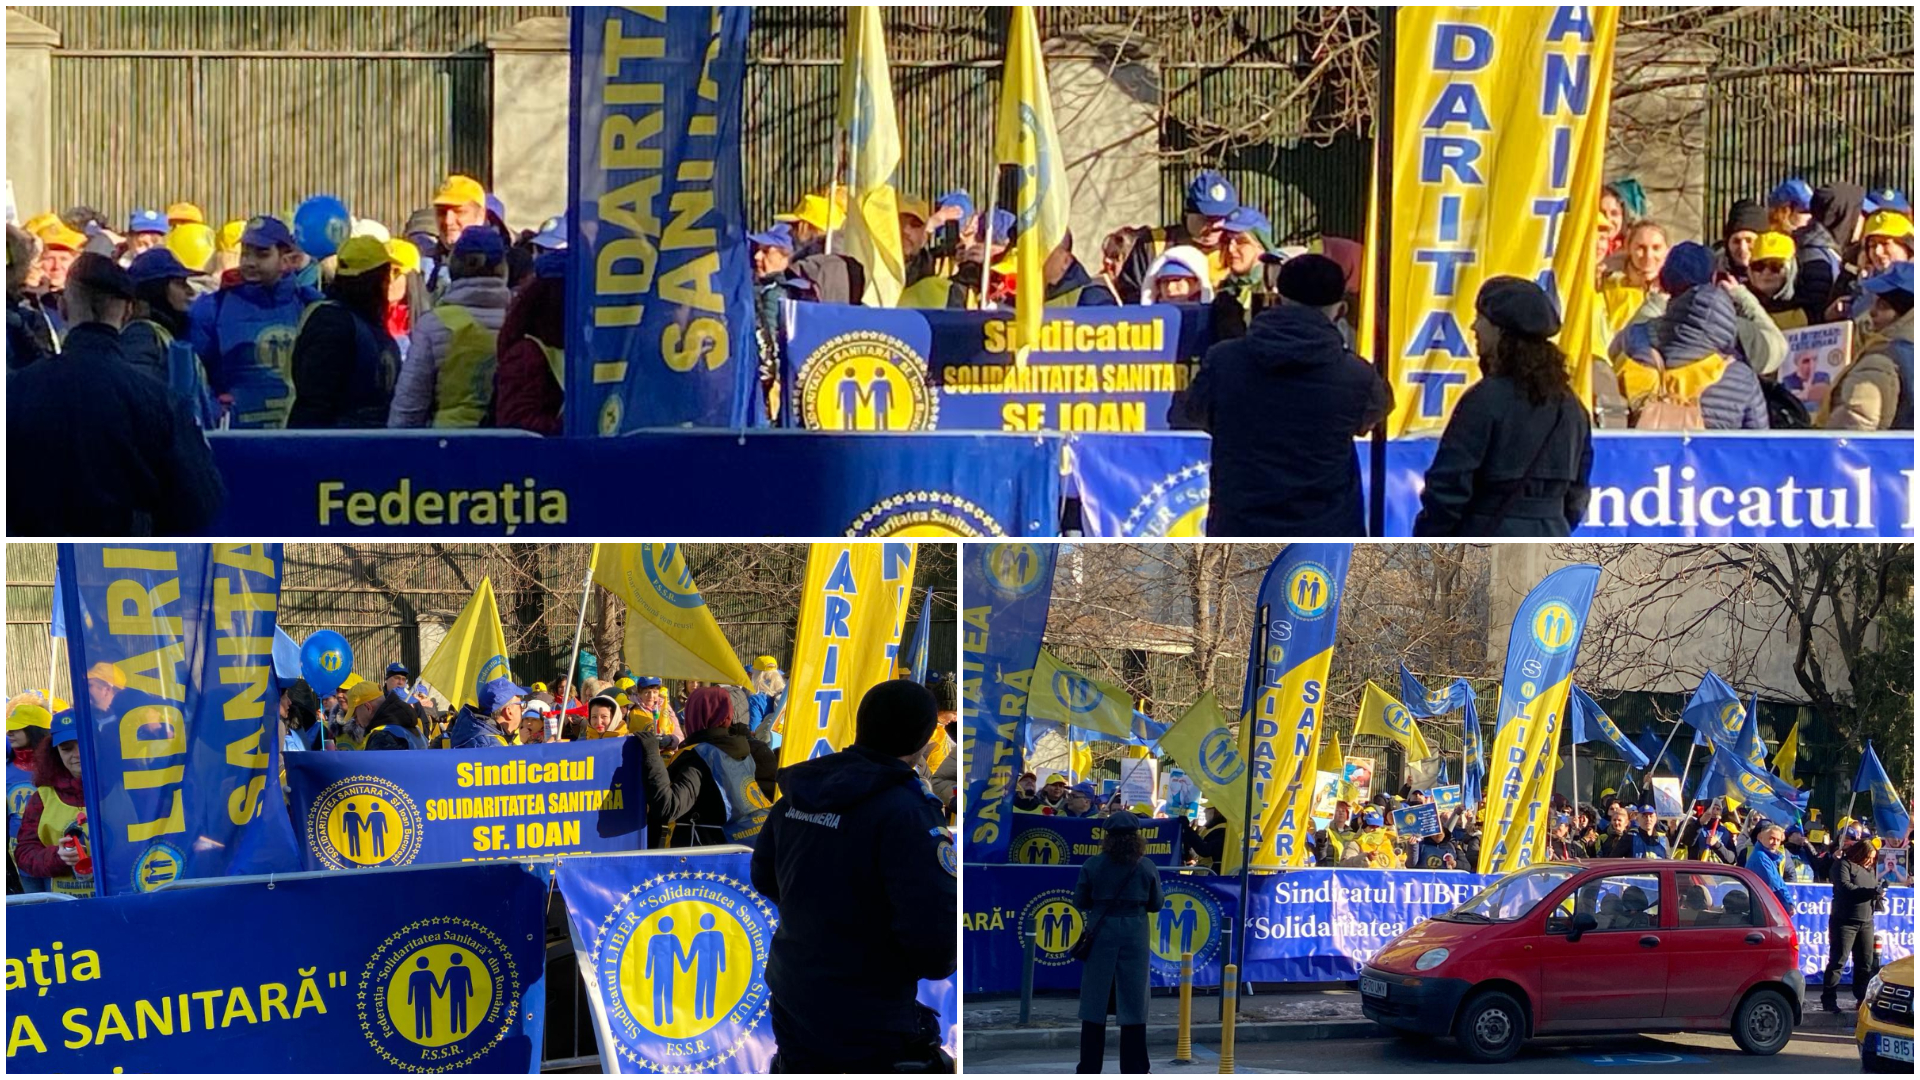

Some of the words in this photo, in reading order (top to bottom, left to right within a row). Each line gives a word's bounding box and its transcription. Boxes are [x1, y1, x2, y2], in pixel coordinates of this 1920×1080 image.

[1404, 6, 1496, 418] DARITAT
[984, 318, 1164, 353] Sidicatul
[943, 364, 1099, 394] SOLIDARITATEA
[1059, 401, 1146, 431] IOAN
[318, 479, 568, 535] Federația
[456, 755, 595, 787] Sindicatul
[1275, 680, 1322, 866] SANITAR
[426, 794, 545, 821] SOLIDARITATEA
[548, 783, 624, 814] SANITARĂ
[472, 824, 510, 851] SF.
[516, 820, 581, 850] IOAN
[1275, 880, 1396, 905] Sindicatul
[608, 911, 641, 965] LIBER
[487, 957, 501, 975] din
[373, 985, 394, 1038] Federația
[487, 975, 505, 1024] România
[604, 971, 641, 1040] Sindicatul
[729, 982, 764, 1025] SUUB
[421, 1044, 464, 1060] F.S.S.R.
[665, 1039, 710, 1056] F.S.S.R.
[1883, 1038, 1890, 1053] B
[1894, 1040, 1910, 1056] 815
